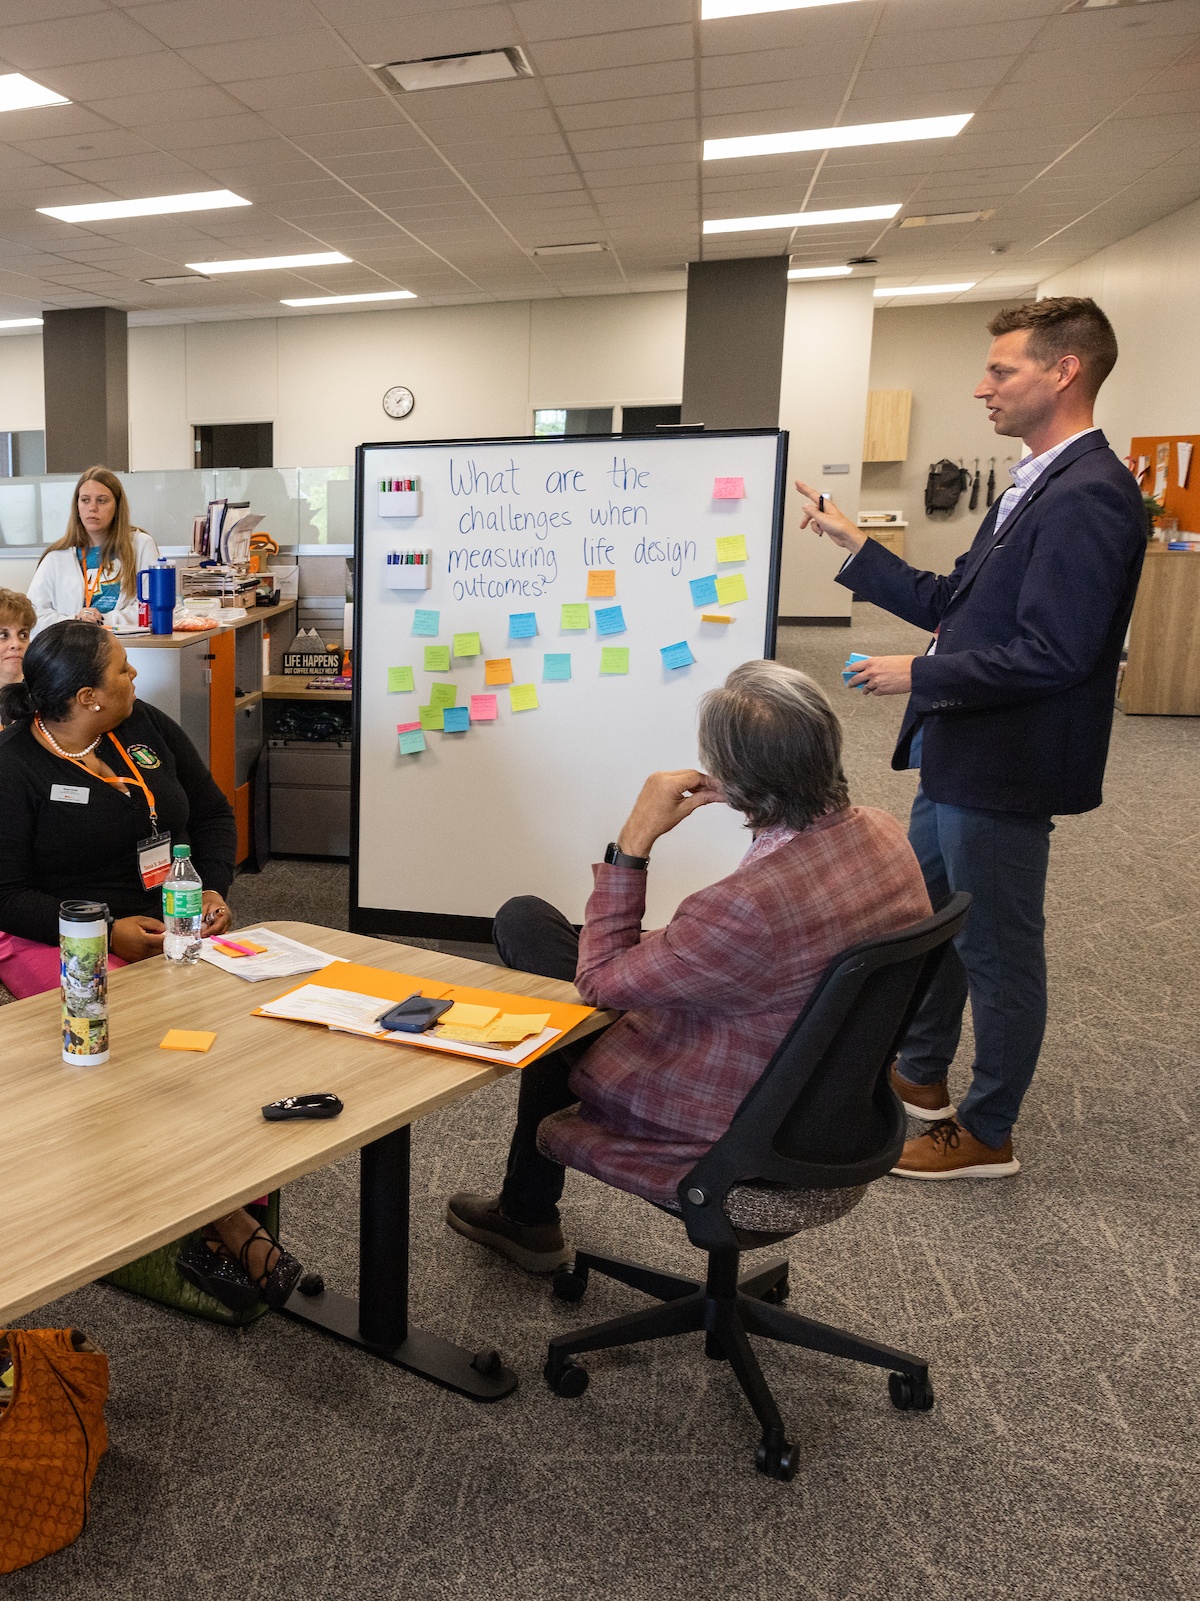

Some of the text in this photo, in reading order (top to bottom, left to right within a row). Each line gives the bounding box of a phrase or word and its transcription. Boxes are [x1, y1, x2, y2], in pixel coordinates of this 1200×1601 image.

[449, 456, 650, 496] What are the
[458, 500, 649, 541] challenges when
[447, 546, 558, 584] measuring
[583, 537, 616, 567] life
[634, 536, 697, 577] design
[452, 573, 548, 602] outcomes?
[284, 654, 339, 667] LIFE HAPPENS
